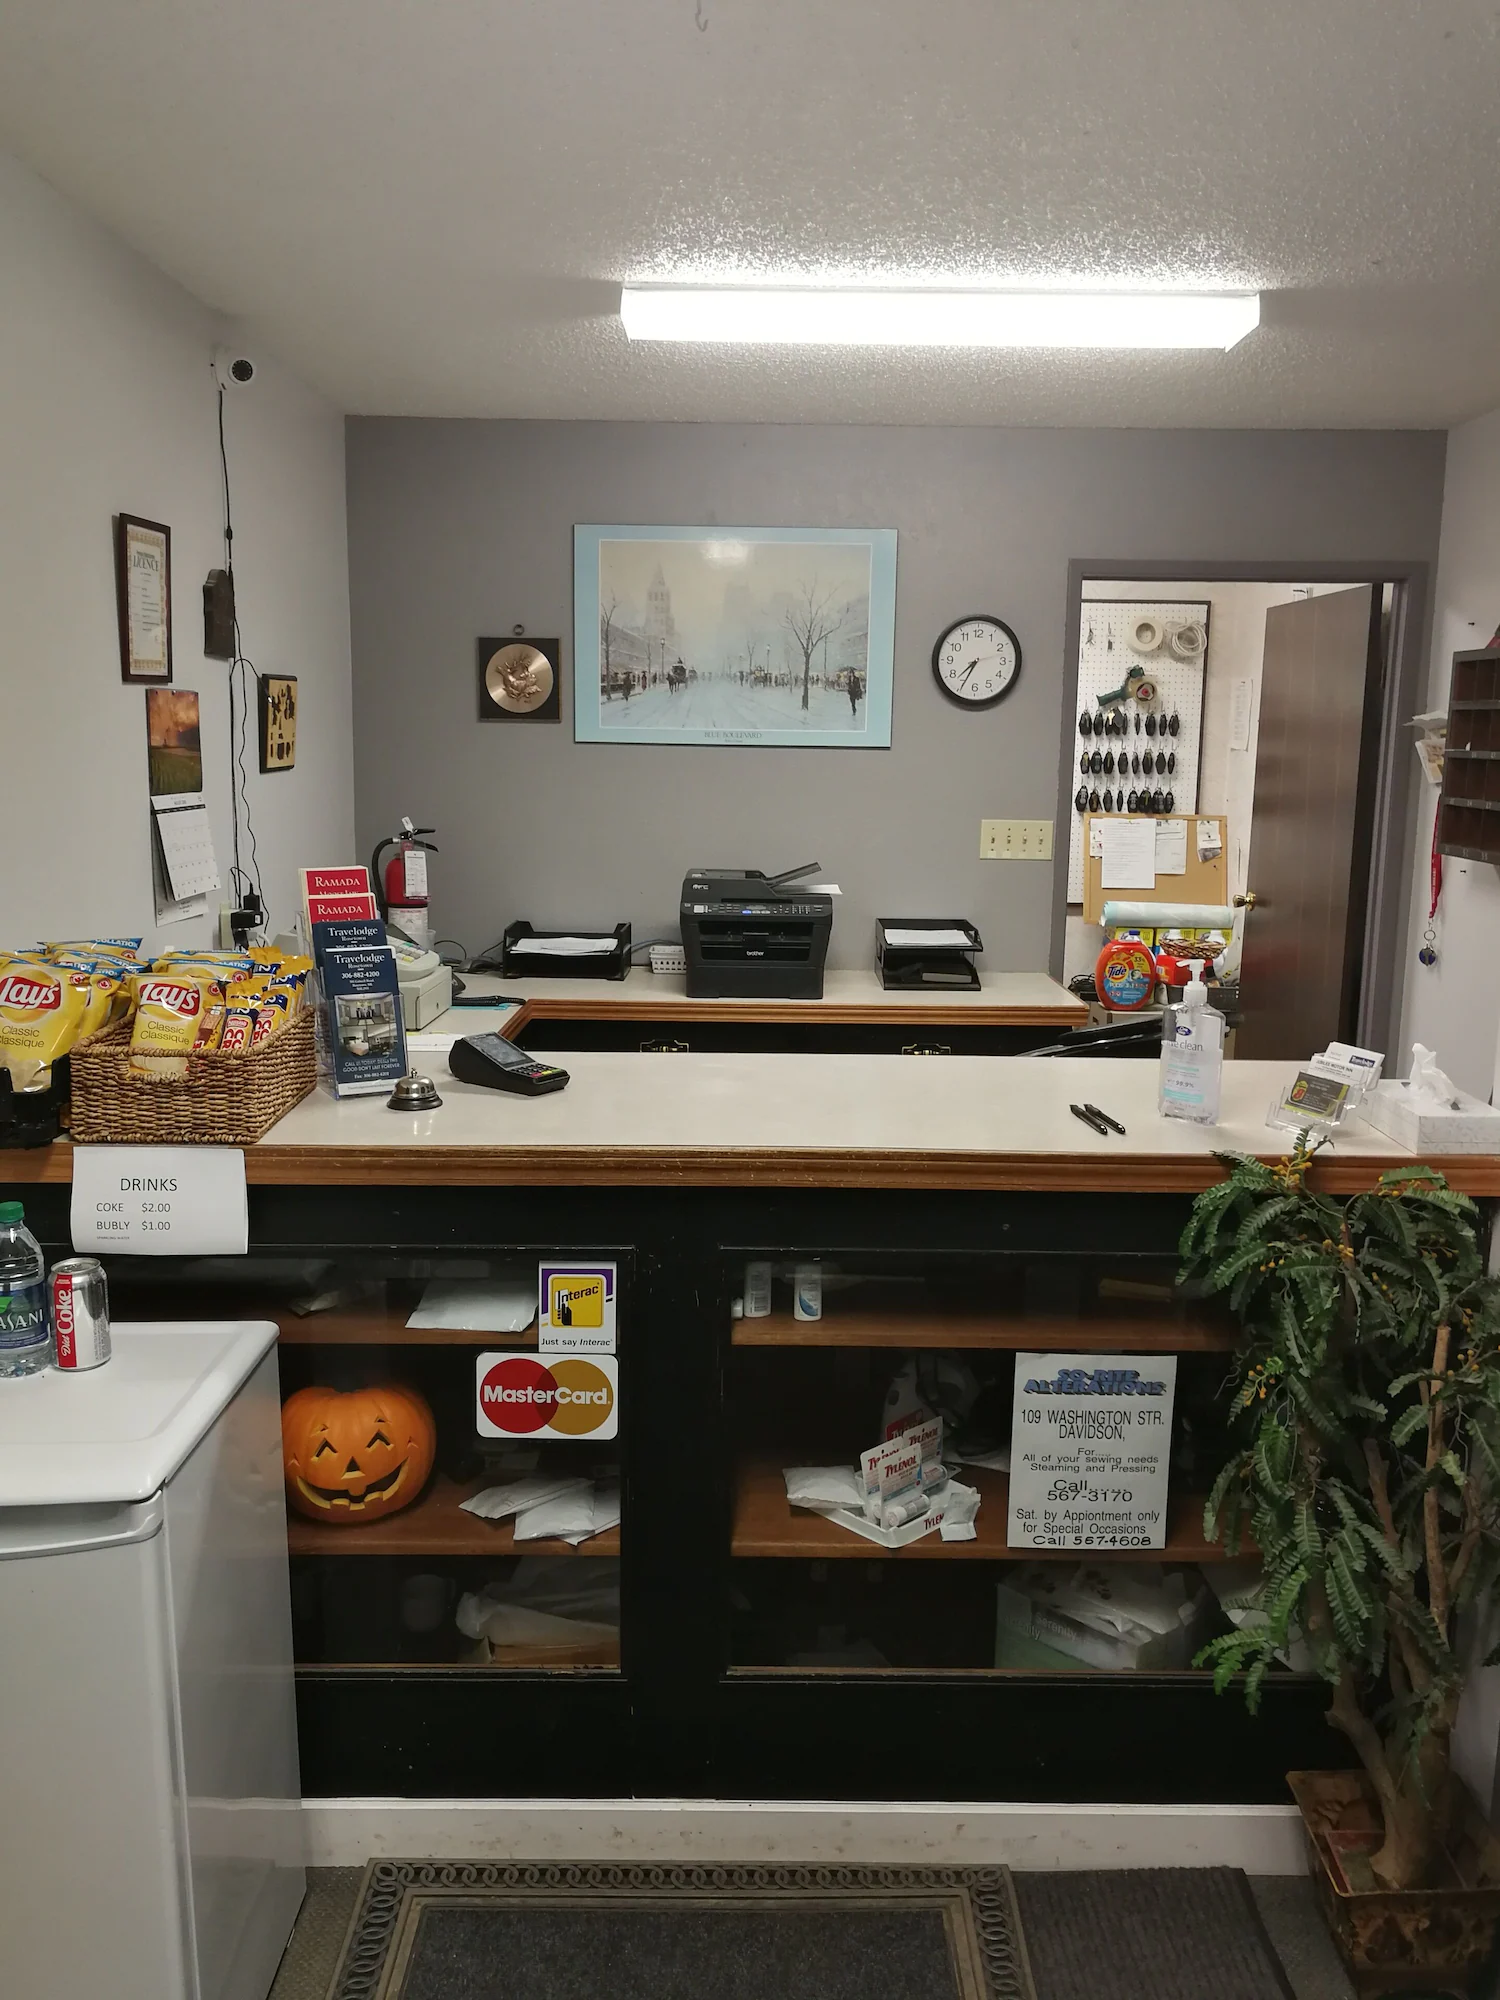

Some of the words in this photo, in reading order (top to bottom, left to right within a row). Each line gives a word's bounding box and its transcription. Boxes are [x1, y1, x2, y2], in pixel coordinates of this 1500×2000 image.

[961, 632, 968, 641] 11
[973, 629, 984, 638] 12
[988, 633, 993, 642] 1
[950, 643, 962, 652] 10
[996, 643, 1004, 652] 2
[946, 656, 954, 664] 9
[1000, 657, 1006, 665] 3
[950, 670, 956, 678] 8
[996, 670, 1002, 678] 4
[972, 683, 978, 692] 6
[985, 680, 992, 688] 5
[315, 876, 360, 887] RAMADA
[317, 904, 363, 915] RAMADA
[328, 926, 378, 936] Travelodge
[334, 953, 385, 964] Travelodge
[1108, 966, 1126, 978] Tide
[140, 983, 199, 1011] Lay's
[2, 1025, 40, 1037] Classic
[148, 1021, 184, 1034] Classic
[0, 1035, 44, 1048] lassique
[140, 1031, 189, 1045] Classique
[1180, 1040, 1203, 1052] clean
[120, 1178, 178, 1192] DRINKS
[96, 1203, 124, 1212] COKE
[141, 1202, 171, 1213] $2.00
[96, 1221, 130, 1230] BUBLY
[141, 1221, 171, 1231] $1.00
[56, 1289, 74, 1334] Coke
[0, 1309, 43, 1332] ASANI
[60, 1335, 71, 1356] Diet
[541, 1338, 559, 1346] Just
[562, 1339, 577, 1347] say
[1023, 1379, 1167, 1396] ALTERATIONS
[484, 1385, 608, 1405] MasterCard
[1022, 1409, 1041, 1423] 109
[1048, 1410, 1132, 1425] WASHINGTON
[1138, 1411, 1164, 1425] STR.
[1060, 1425, 1125, 1442] DAVIDSON,
[1023, 1454, 1036, 1462] All
[1057, 1456, 1080, 1464] your
[1086, 1456, 1122, 1464] sewing
[884, 1455, 916, 1478] TYLENOL
[1030, 1463, 1080, 1473] Steaming
[1111, 1464, 1156, 1474] Pressing
[1047, 1490, 1132, 1502] 567-3170
[1016, 1508, 1038, 1520] Sat.
[1044, 1510, 1058, 1522] by
[1063, 1510, 1132, 1523] Appiontment
[1138, 1510, 1160, 1523] only
[924, 1513, 944, 1530] TYLEN
[1023, 1522, 1038, 1533] for
[1043, 1522, 1083, 1536] Special
[1090, 1523, 1146, 1534] Occasions
[1033, 1535, 1066, 1546] Call
[1073, 1536, 1151, 1546] 567-4608
[1035, 1612, 1077, 1642] Serenity
